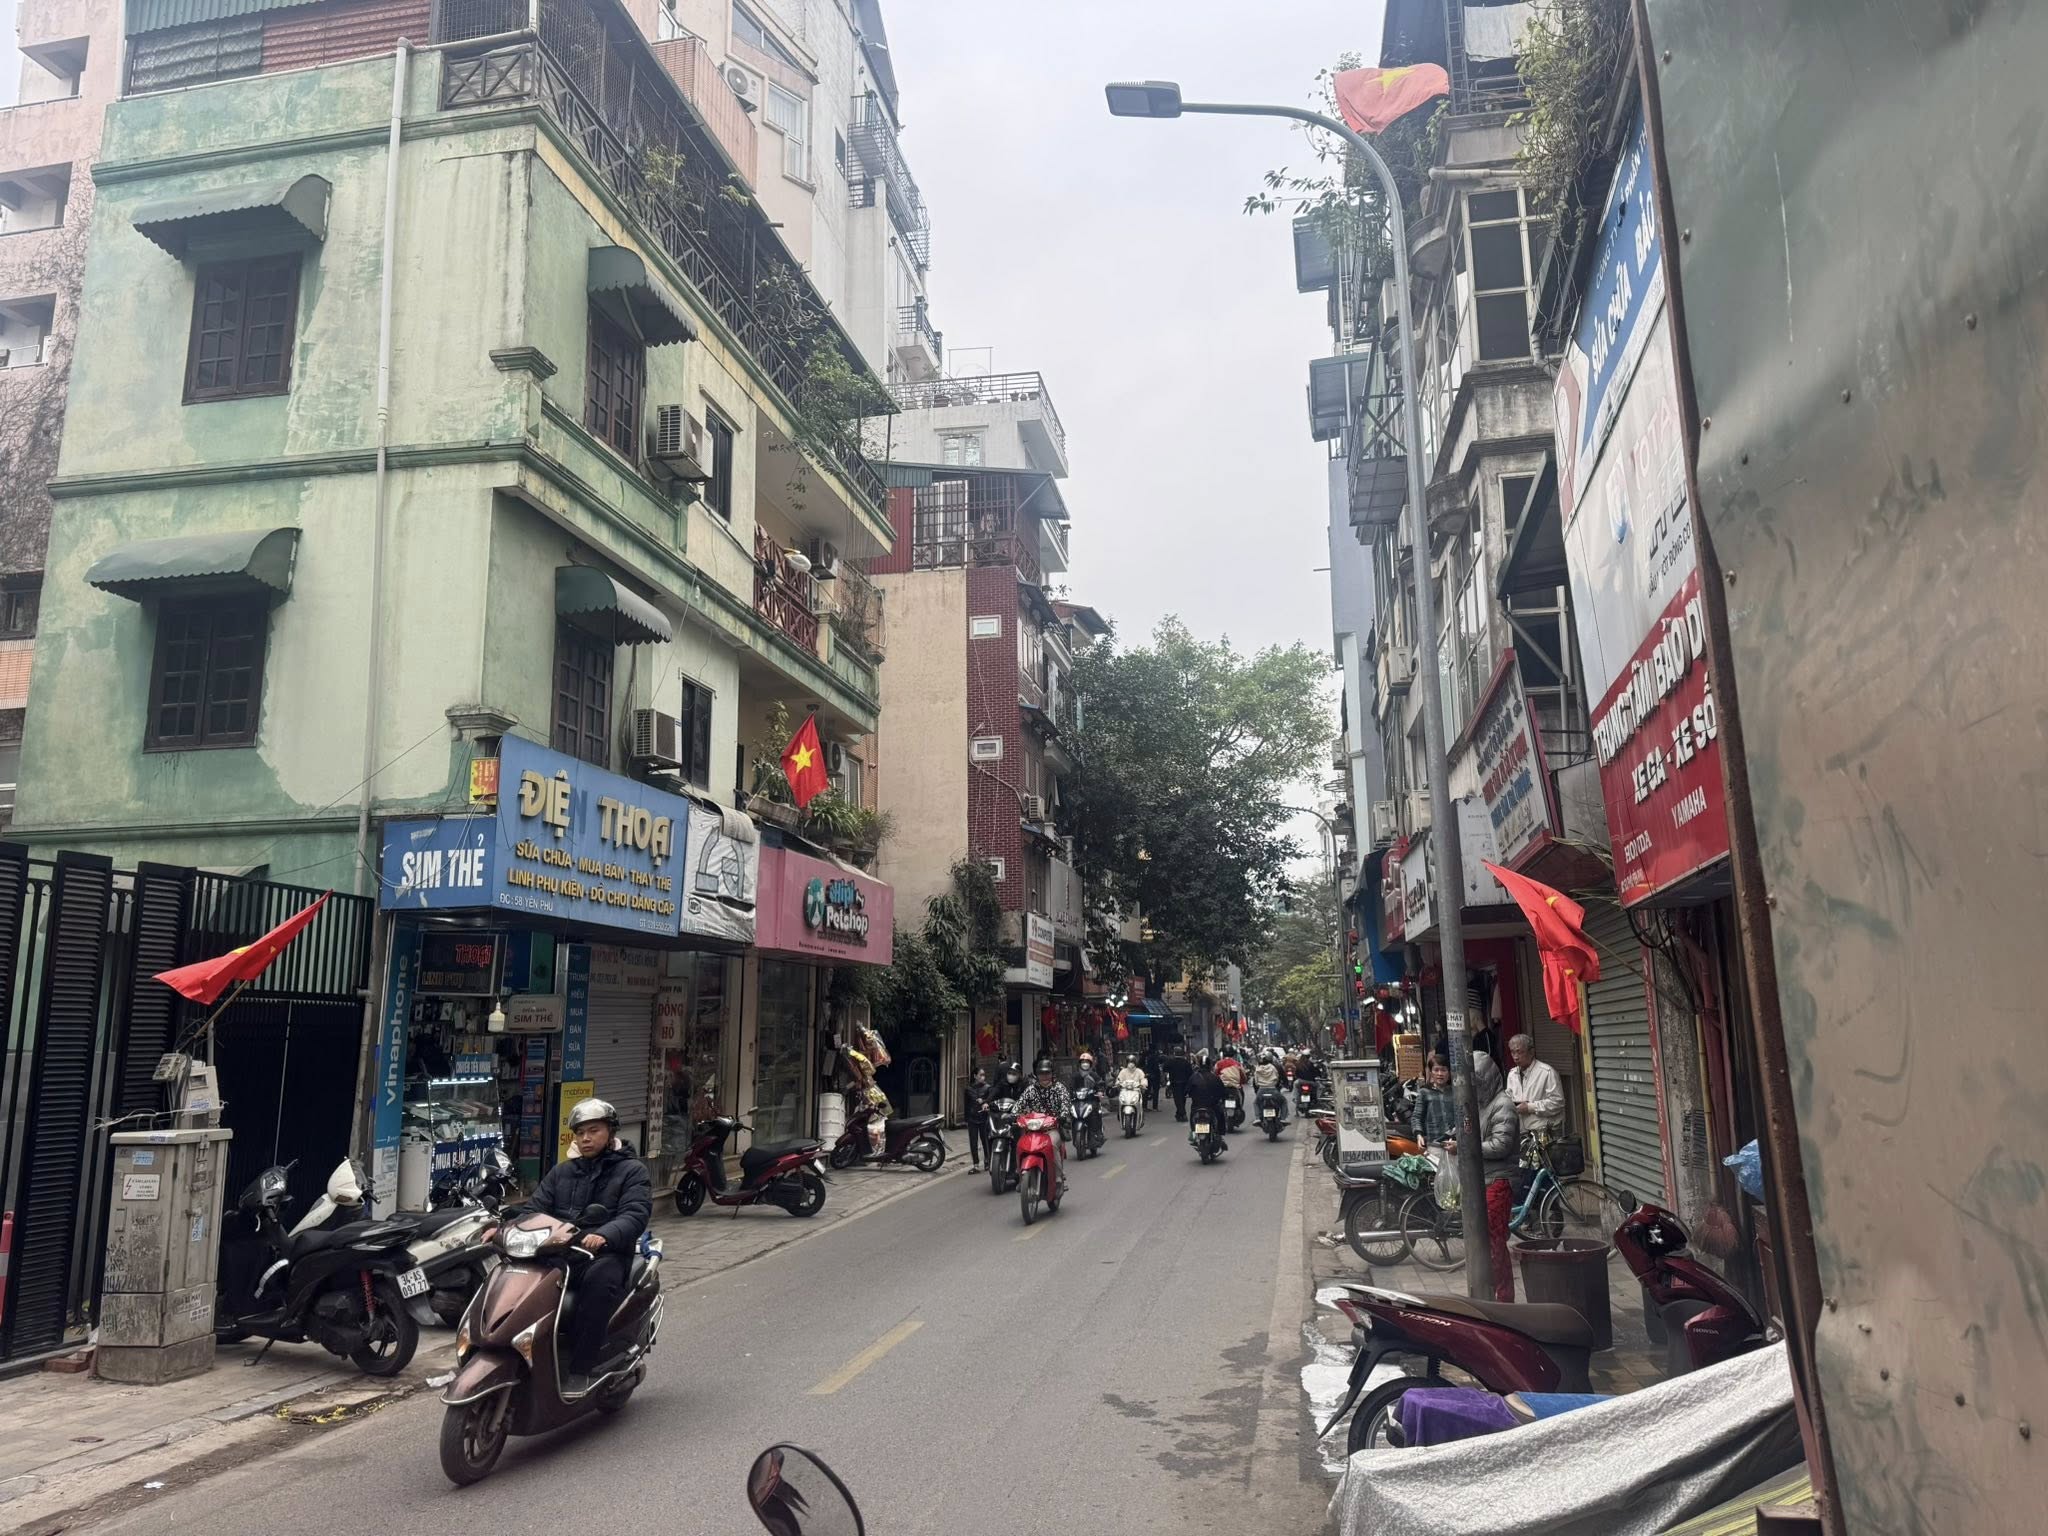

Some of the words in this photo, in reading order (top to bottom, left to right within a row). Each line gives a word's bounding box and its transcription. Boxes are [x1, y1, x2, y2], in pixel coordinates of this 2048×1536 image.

[1592, 315, 1608, 386] SỬA
[1607, 260, 1632, 346] CHỮA
[1635, 190, 1655, 275] BẢO
[1592, 690, 1630, 769] TRUNG
[1625, 659, 1655, 730] TÂM
[1652, 615, 1690, 700] BẢO
[1631, 757, 1648, 805] XE
[1647, 745, 1668, 791] GA
[1672, 716, 1695, 769] XE
[1692, 670, 1718, 750] SỐ
[1671, 785, 1707, 829] YAMAHA
[401, 850, 442, 890] SIM
[447, 833, 486, 888] THẺ
[1624, 829, 1652, 865] HONDA
[516, 837, 540, 861] SỬA
[543, 846, 572, 869] CHỮA
[579, 857, 601, 875] MUA
[604, 861, 625, 881] BÁN
[631, 869, 654, 887] THAY
[656, 871, 672, 892] THẾ
[508, 868, 534, 887] LINH
[536, 874, 559, 898] PHỤ
[560, 878, 585, 900] KIỆN
[590, 882, 606, 903] ĐỒ
[657, 898, 676, 917] CẤP
[524, 895, 537, 909] YÊN
[826, 905, 868, 936] Petshop
[455, 944, 492, 968] THOẠI
[514, 1014, 532, 1024] SIM
[569, 1007, 583, 1017] MUA
[384, 953, 409, 1106] vinaphone
[569, 1023, 582, 1034] BÁN
[568, 1041, 580, 1052] SỬA
[565, 1059, 581, 1070] CHỮA
[436, 1152, 451, 1171] MUA
[1692, 1327, 1720, 1336] HONDA
